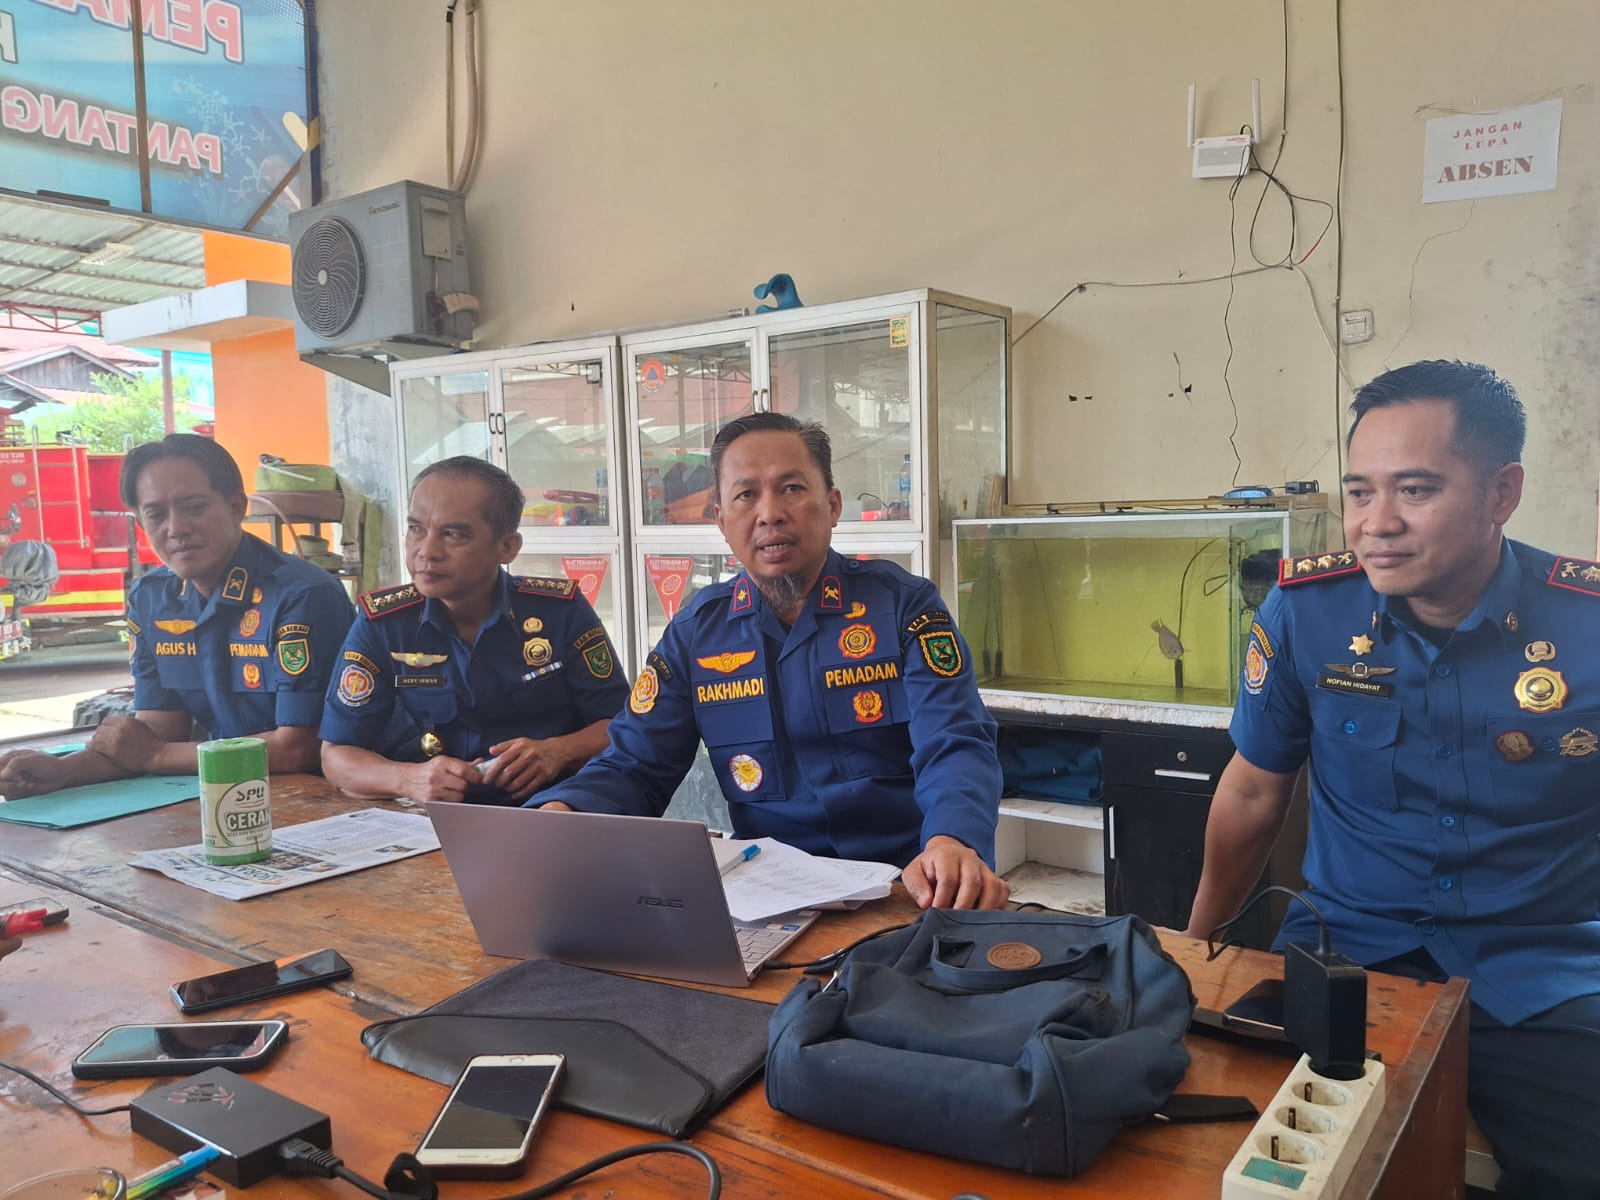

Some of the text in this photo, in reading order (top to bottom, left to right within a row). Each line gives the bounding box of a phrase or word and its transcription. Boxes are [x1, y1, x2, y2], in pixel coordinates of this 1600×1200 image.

[1453, 121, 1522, 139] JANGAN
[1465, 138, 1508, 150] LUPA
[1437, 155, 1534, 183] ABSEN
[156, 642, 196, 656] AGUS H
[229, 643, 270, 657] PEMADAM
[825, 662, 898, 688] PEMADAM
[697, 677, 764, 703] RAKHMADI
[1326, 678, 1381, 692] NOFIAN HIDAYAT
